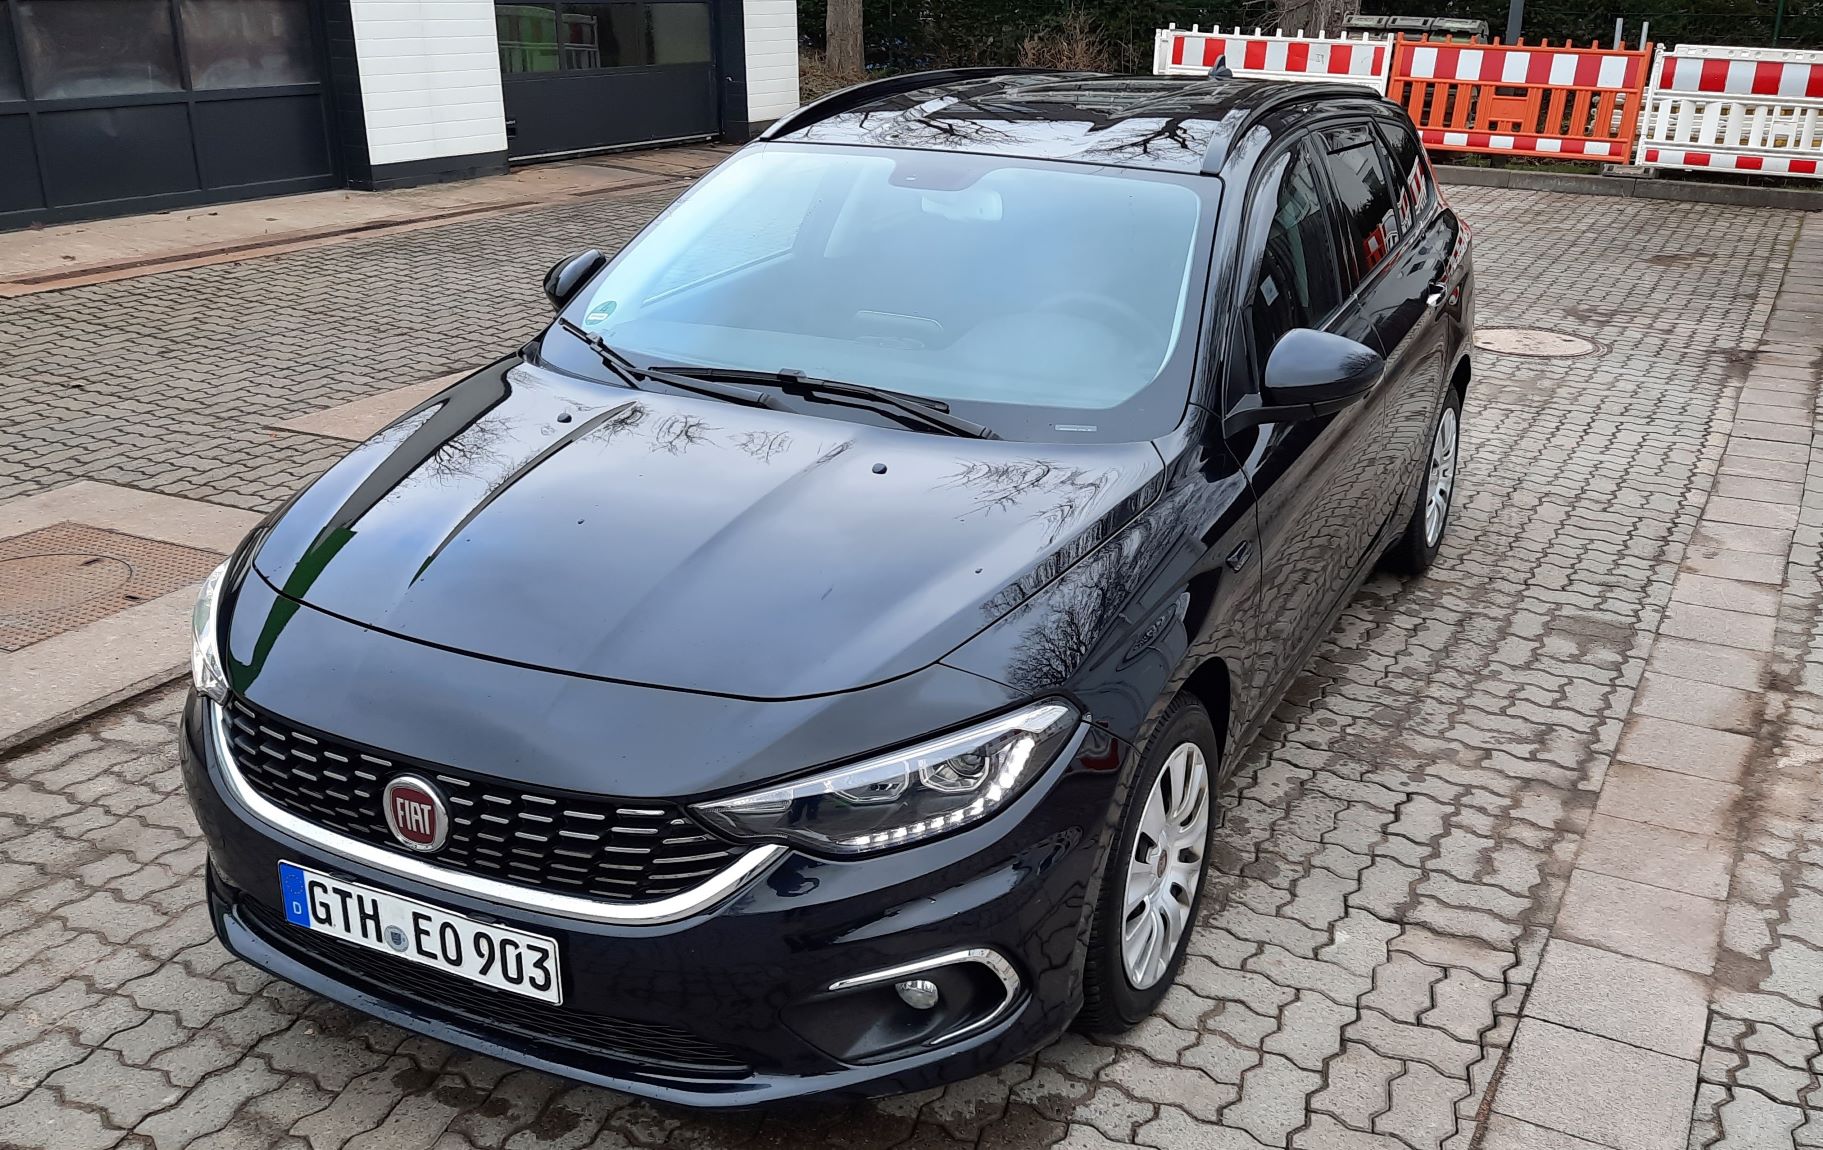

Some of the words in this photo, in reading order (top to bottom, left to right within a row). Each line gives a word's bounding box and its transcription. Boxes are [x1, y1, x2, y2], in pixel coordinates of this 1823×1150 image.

[396, 797, 432, 836] FIAT
[293, 901, 302, 915] D
[308, 879, 384, 943] GTH
[412, 911, 463, 967] EO
[473, 931, 552, 992] 903
